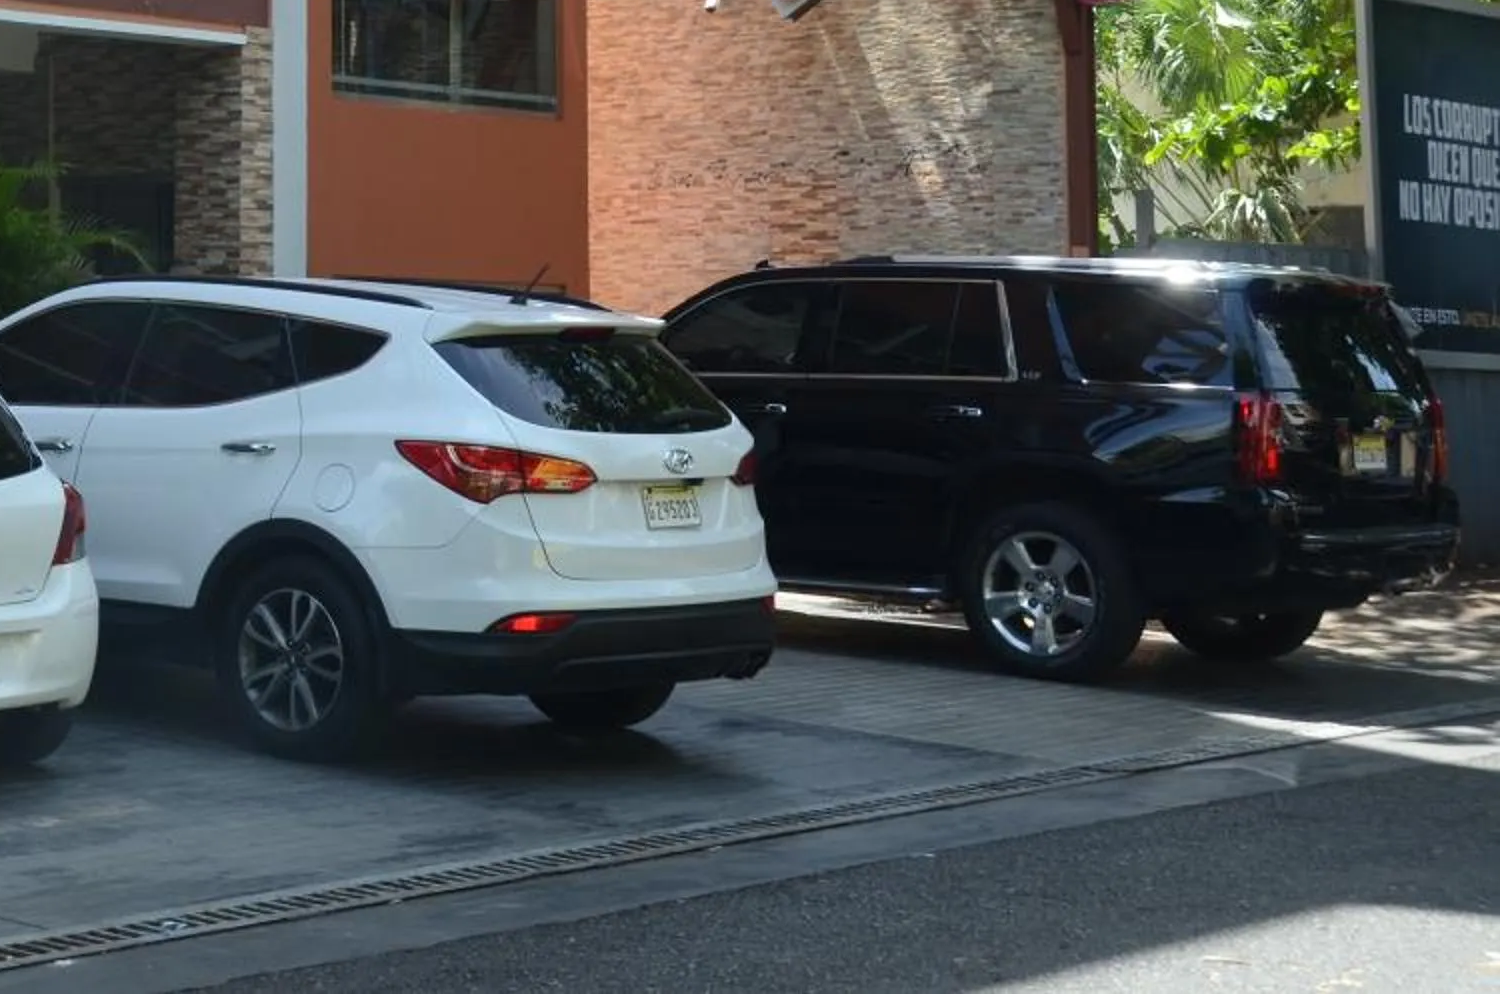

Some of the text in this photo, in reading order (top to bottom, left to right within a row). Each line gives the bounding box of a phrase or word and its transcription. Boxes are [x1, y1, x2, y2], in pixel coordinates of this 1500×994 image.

[1403, 93, 1431, 136] LOS
[1427, 139, 1500, 188] DICEN QUE
[1399, 179, 1420, 222] NO
[1421, 182, 1450, 224] HAY
